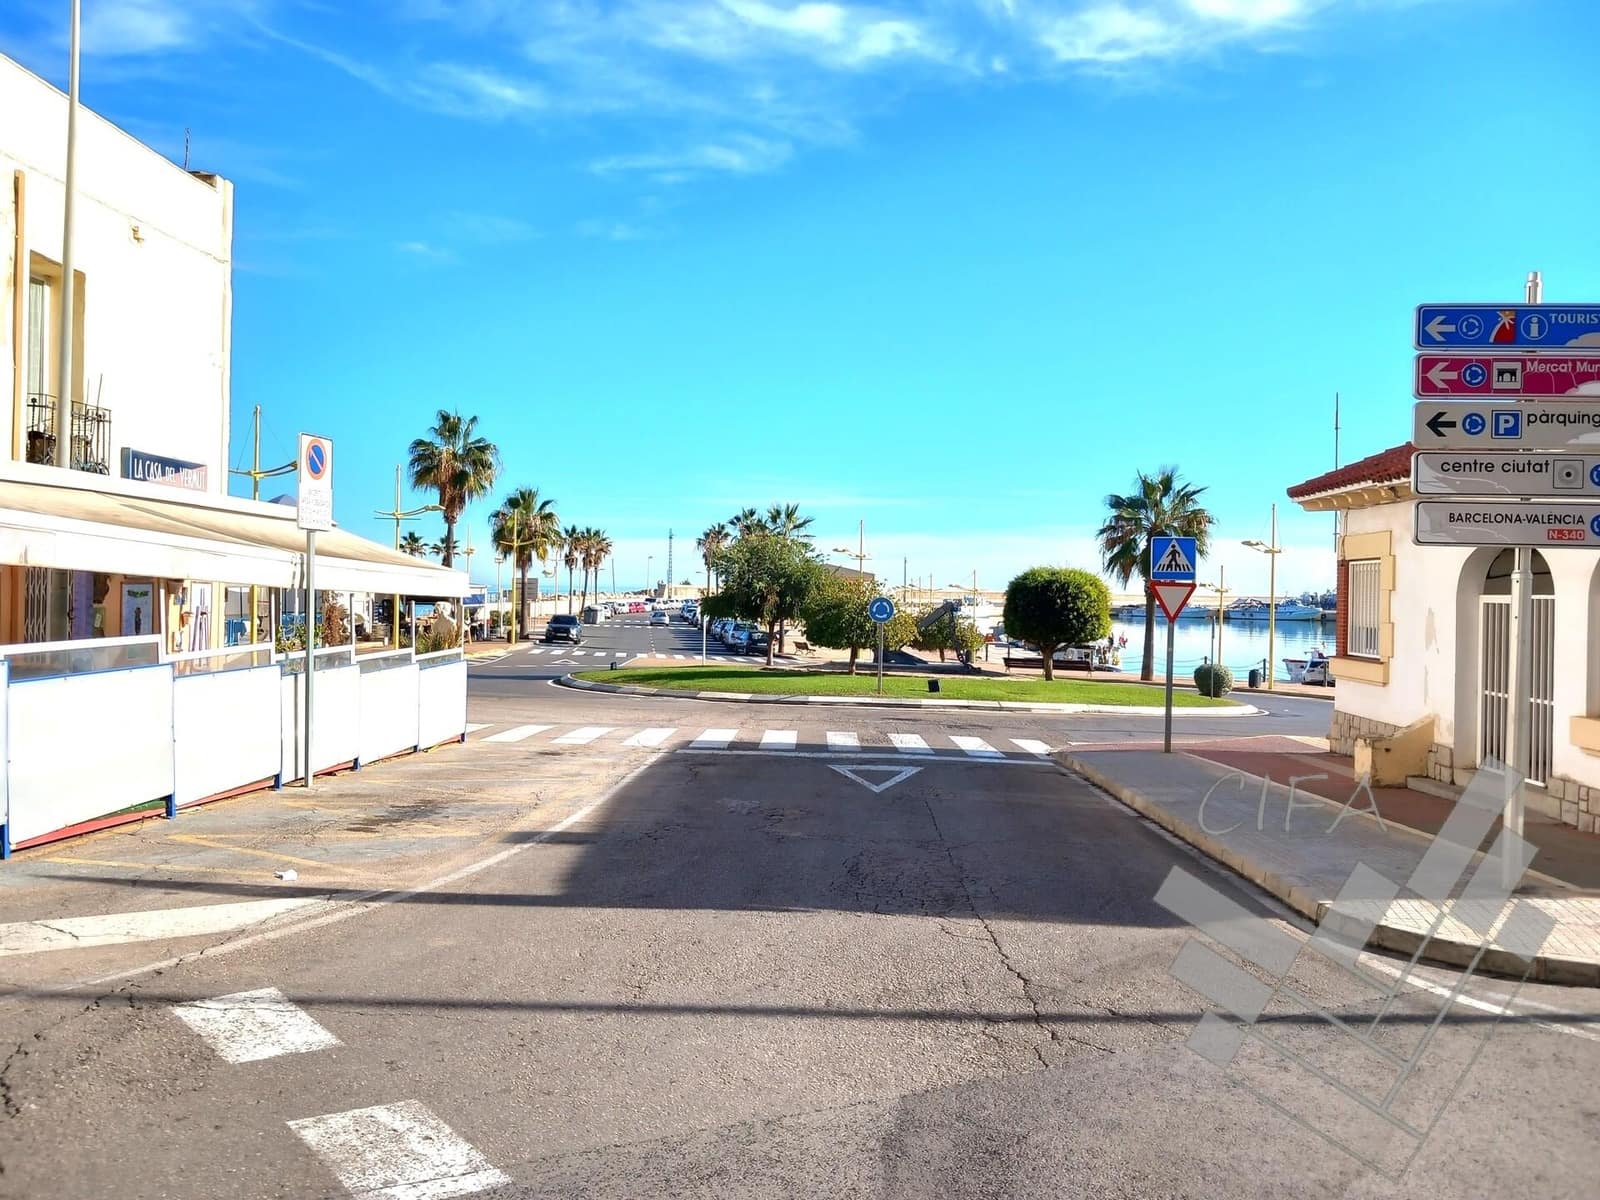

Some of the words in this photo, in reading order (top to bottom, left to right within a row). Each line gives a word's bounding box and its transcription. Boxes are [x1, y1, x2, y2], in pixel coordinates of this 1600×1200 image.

[1549, 313, 1600, 324] TOURIS
[1526, 360, 1573, 373] Mercat
[1498, 414, 1515, 435] P
[134, 458, 143, 479] LA
[145, 461, 162, 480] CASA
[165, 466, 175, 481] DEL
[1441, 459, 1496, 473] centre
[1501, 459, 1551, 473] ciutat
[1548, 530, 1584, 540] N-340
